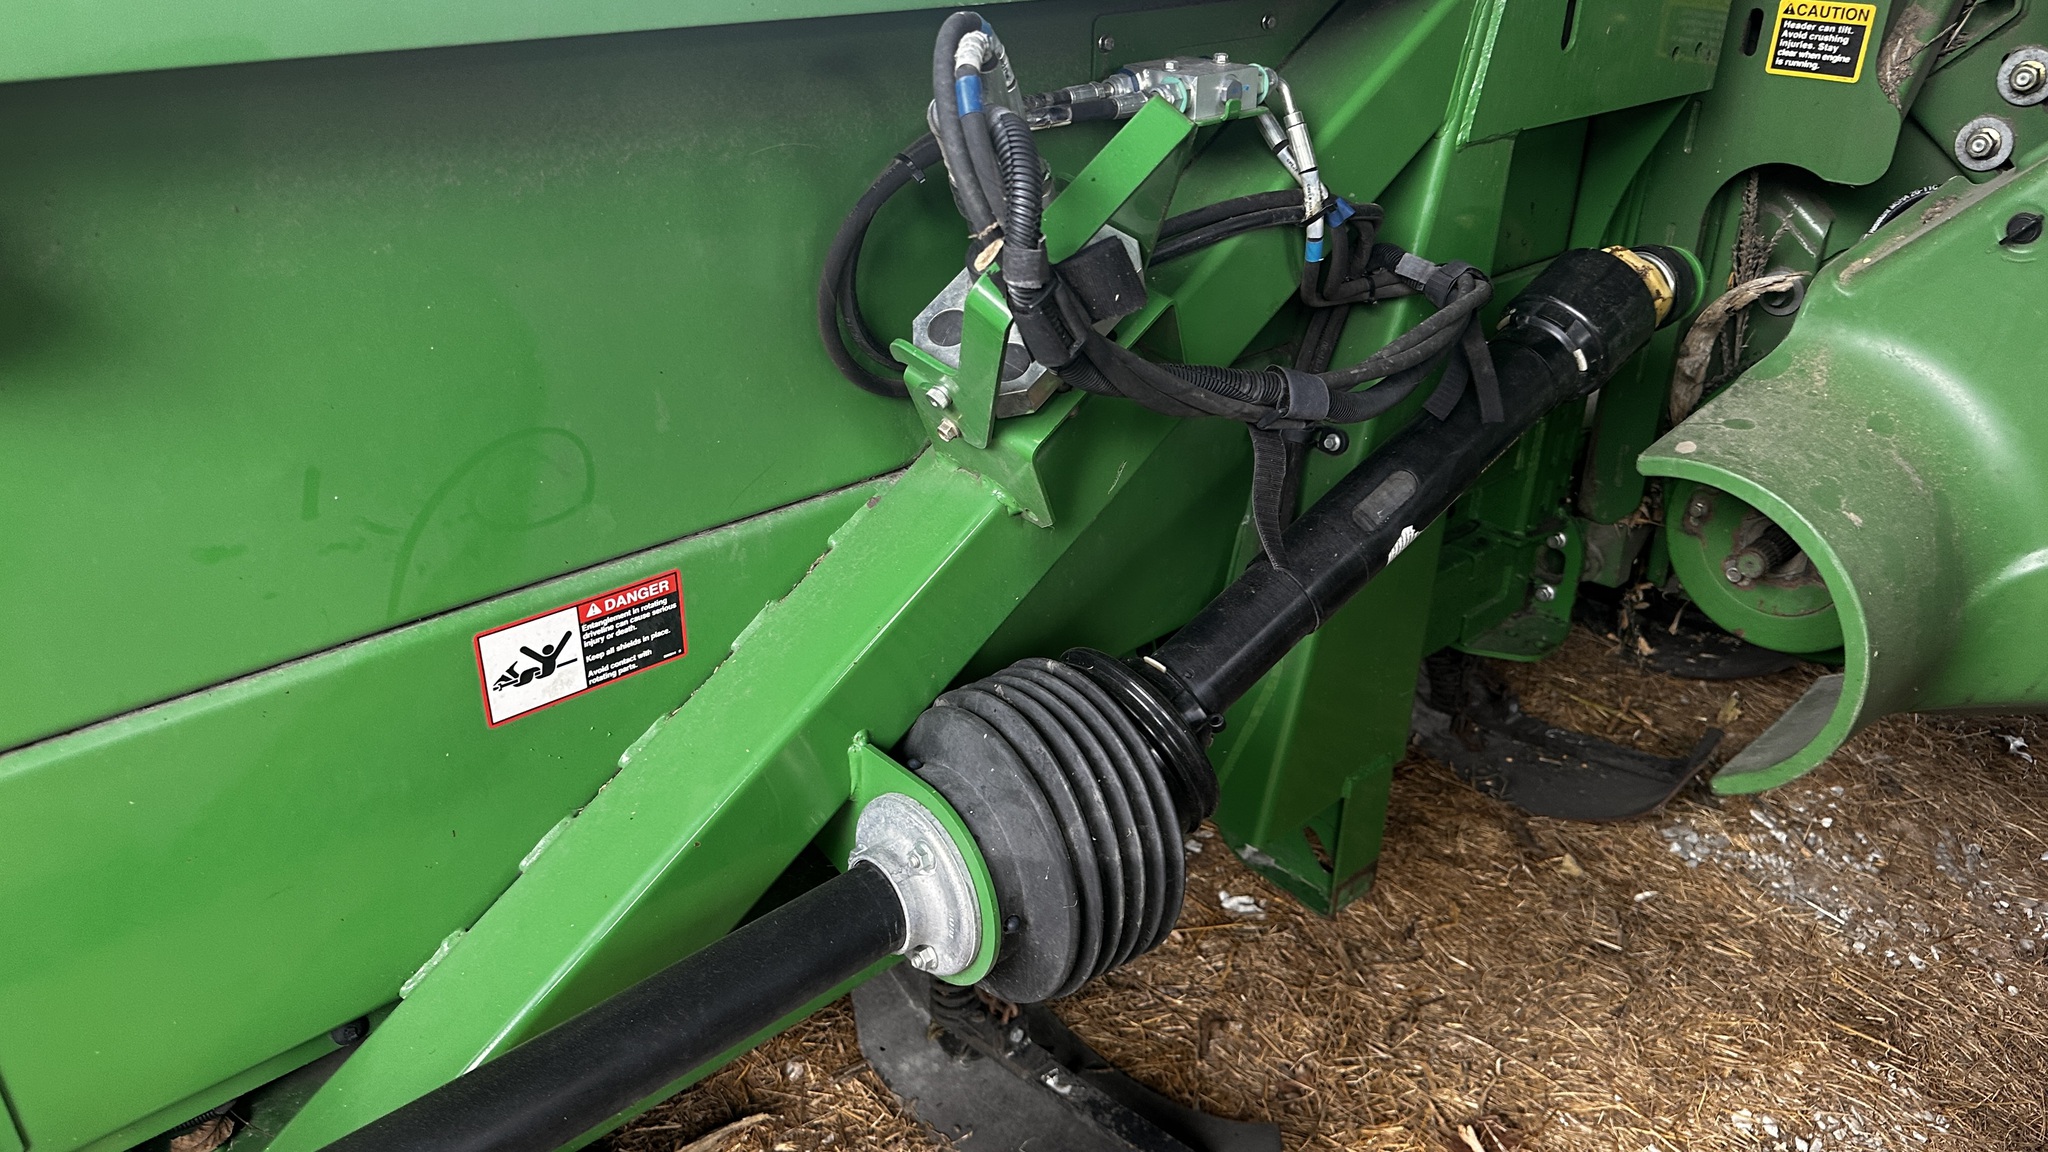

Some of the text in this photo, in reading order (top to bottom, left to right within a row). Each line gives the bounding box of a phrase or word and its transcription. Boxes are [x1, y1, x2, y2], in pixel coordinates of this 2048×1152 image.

[1797, 3, 1870, 21] CAUTION
[1781, 30, 1850, 46] Avoid crushing
[1783, 20, 1854, 35] Header can tilt.
[1777, 48, 1851, 64] clear when engine
[1779, 39, 1839, 54] injuries. Stay
[1775, 57, 1820, 71] is running.
[604, 579, 670, 612] DANGER
[581, 597, 668, 632] Entanglement in rotating
[582, 602, 677, 640] driveline can cause serious
[583, 624, 638, 648] injury or death.
[585, 628, 671, 663] Keep all shields in place.
[587, 664, 610, 678] Avoid
[610, 654, 637, 669] contact
[637, 648, 653, 660] with
[588, 663, 639, 685] rotating parts.
